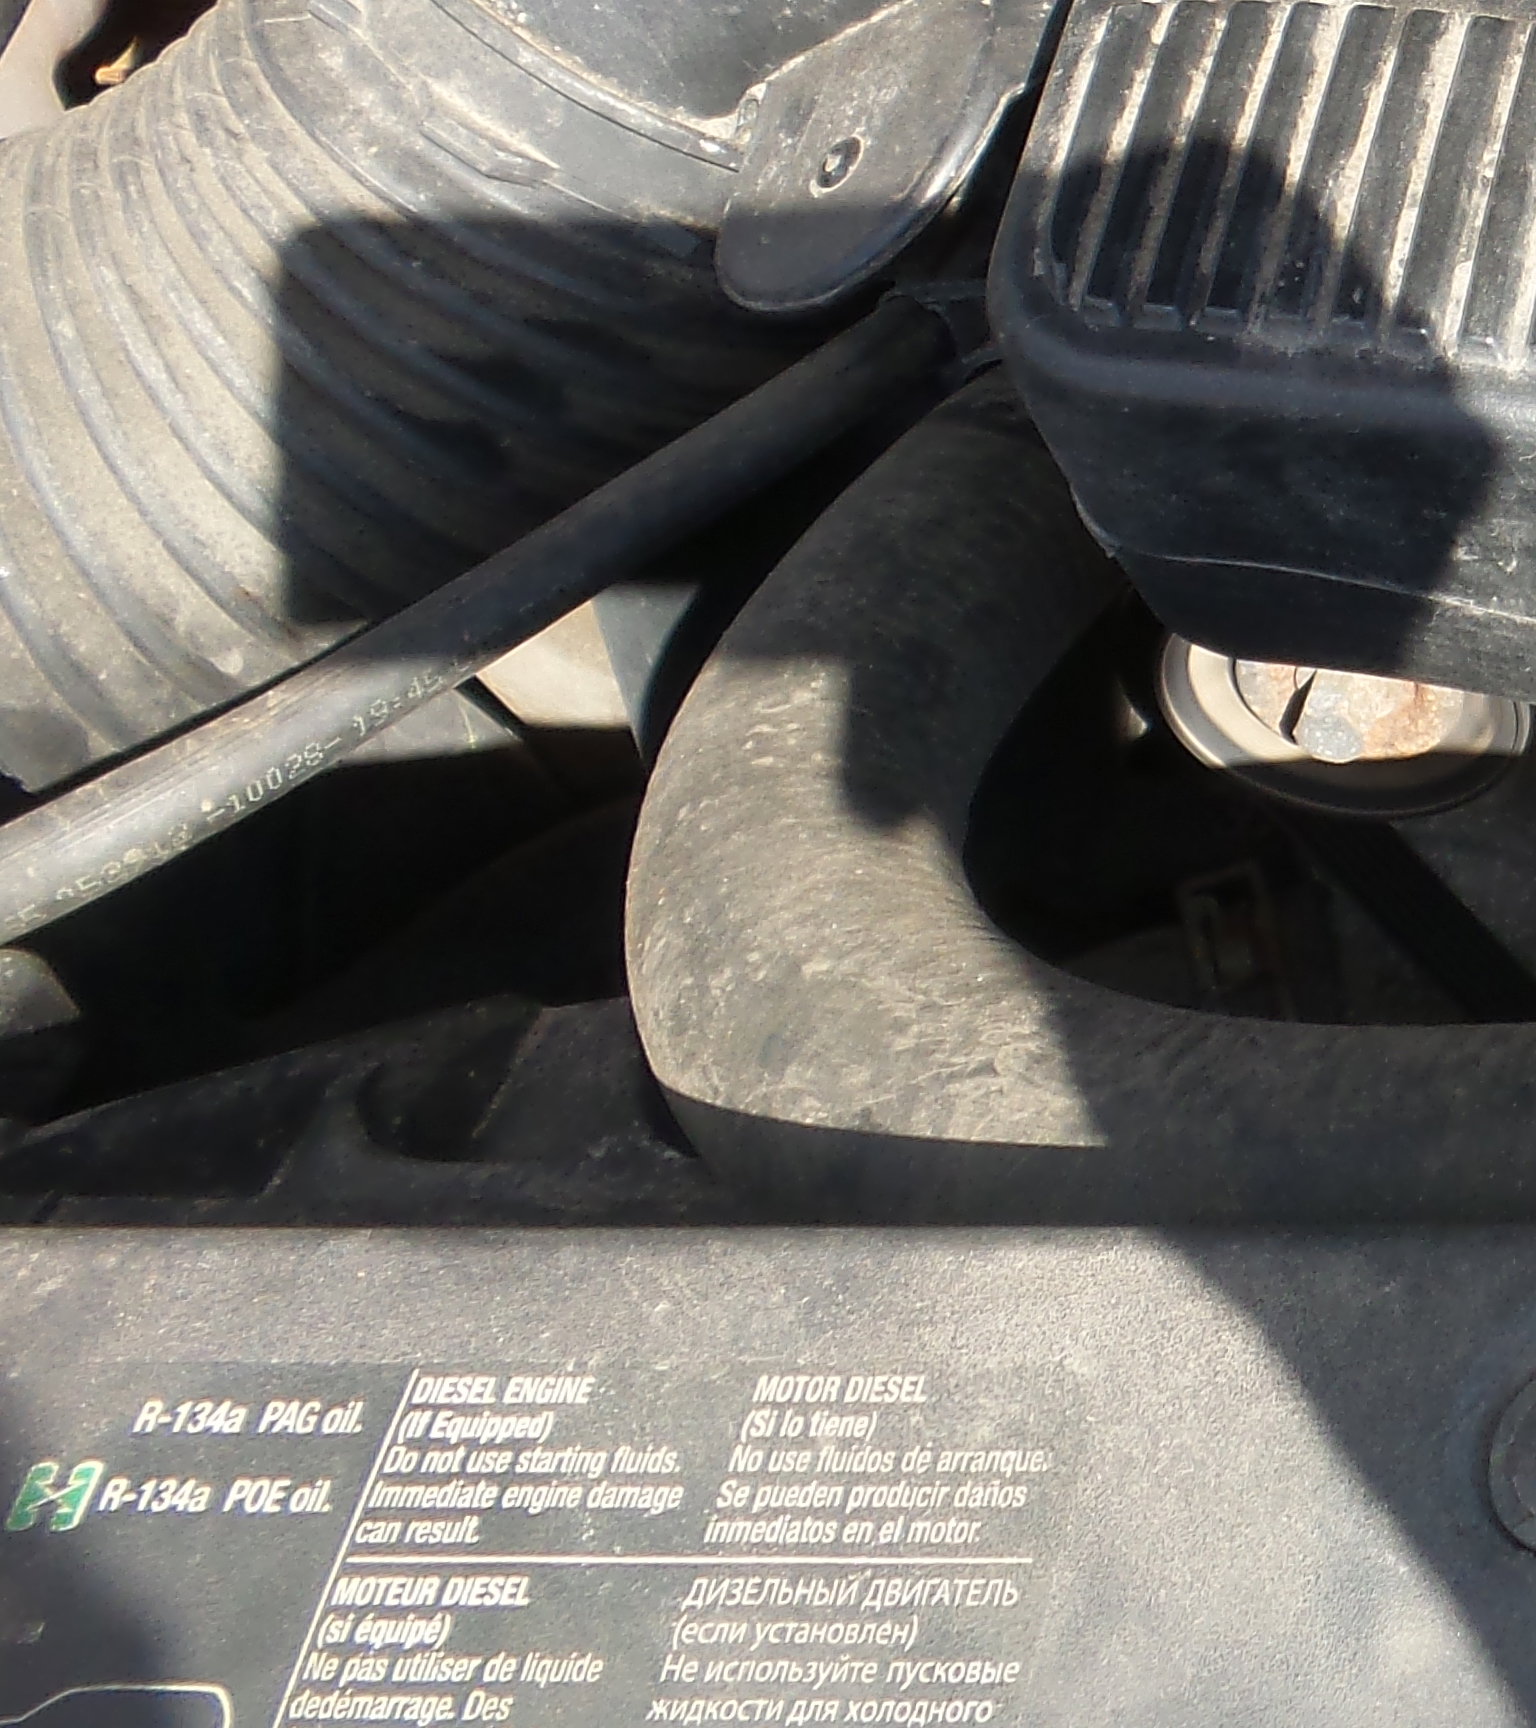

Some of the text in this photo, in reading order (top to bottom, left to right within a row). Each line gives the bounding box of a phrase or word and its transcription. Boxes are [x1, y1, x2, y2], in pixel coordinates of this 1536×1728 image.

[411, 1376, 596, 1404] DIESEL ENGINE
[752, 1375, 928, 1403] MOTOR DIESEL
[132, 1398, 366, 1434] R-134a PAG oil.
[397, 1410, 555, 1444] (If Equipped)
[740, 1408, 878, 1443] (Si lo tiene)
[383, 1445, 681, 1479] Do not use starting fluids.
[728, 1445, 763, 1473] No
[768, 1450, 811, 1473] use
[937, 1449, 1051, 1478] arranque.
[98, 1477, 333, 1513] R-134a POE oil.
[368, 1480, 684, 1516] Immediate engine damage
[716, 1479, 1028, 1514] Se pueden producir daños
[355, 1515, 481, 1544] can result.
[704, 1515, 981, 1544] inmediatos en el motor.
[331, 1576, 531, 1606] MOTEUR DIESEL
[681, 1572, 1019, 1612] ДИЗЕЛЬНЫЙ ДВИГАТЕЛЬ
[316, 1612, 452, 1649] (si équipé)
[672, 1615, 918, 1652] (если установлен)
[302, 1651, 604, 1688] Ne pas utiliser de liquide
[659, 1654, 1020, 1691] Не используйте пусковые
[461, 1687, 514, 1721] Des
[646, 1699, 994, 1727] жидкости для холодного
